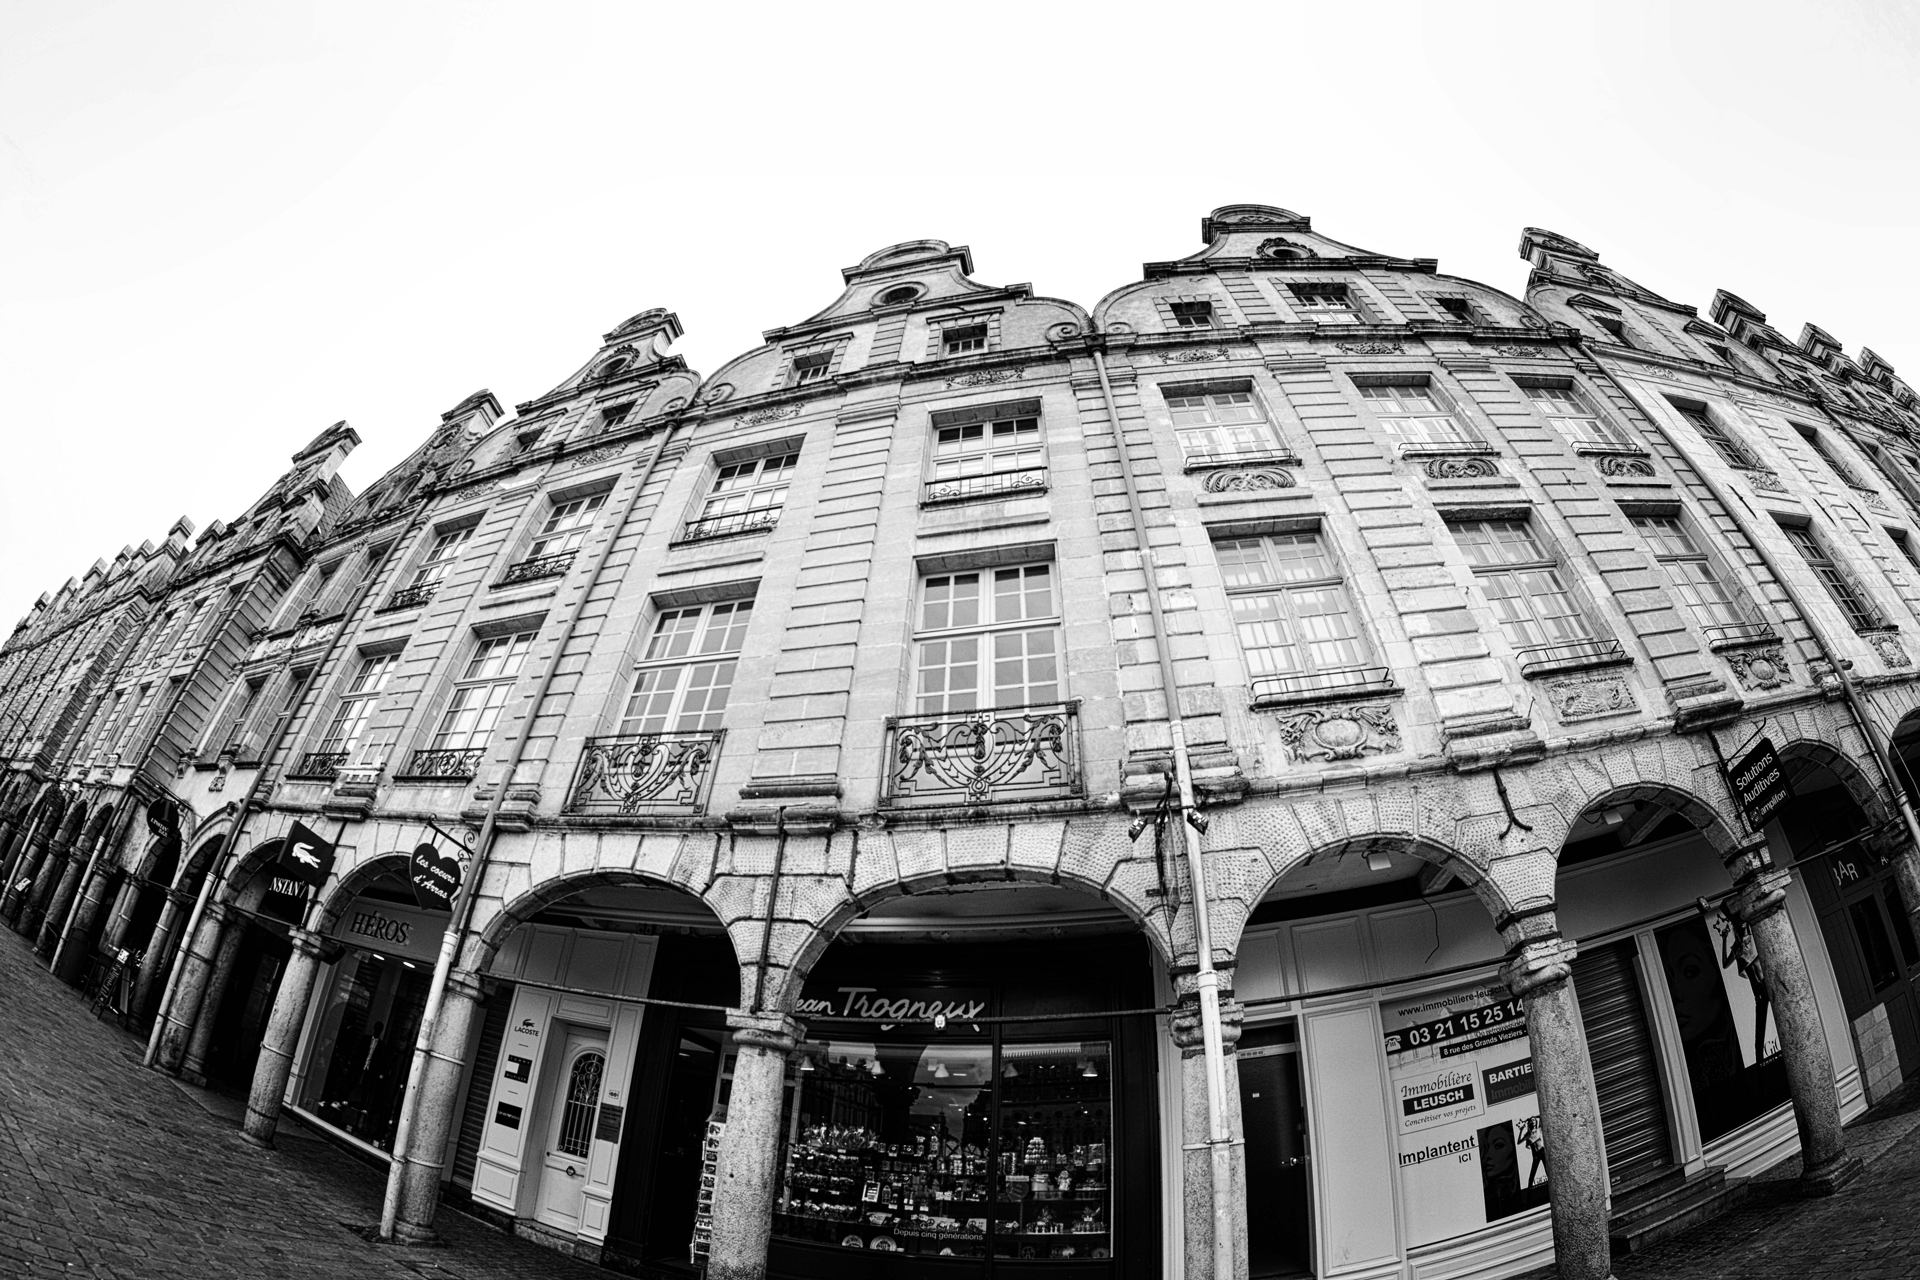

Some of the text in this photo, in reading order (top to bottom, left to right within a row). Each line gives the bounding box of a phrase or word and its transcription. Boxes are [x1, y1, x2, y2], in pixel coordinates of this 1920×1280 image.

[1736, 751, 1773, 790] Solutions
[1743, 767, 1780, 806] Auditives
[1760, 789, 1787, 816] amplifon
[413, 874, 448, 899] d'Arras
[430, 865, 456, 884] coeurs
[350, 910, 410, 943] HÉROS
[794, 987, 985, 1033] ean Trogneux
[1409, 998, 1525, 1046] 03 21 15 25 14
[514, 1025, 540, 1037] LACOSTE
[1461, 1043, 1474, 1051] des
[1474, 1036, 1498, 1048] Grands
[1400, 1070, 1473, 1098] Immobilière
[1413, 1089, 1465, 1112] LEUSCH
[1404, 1104, 1477, 1128] Concrétiser vos projets
[1398, 1135, 1476, 1167] Implantent
[1458, 1152, 1472, 1164] ICI
[893, 1227, 984, 1241] Depuis cinq générations
